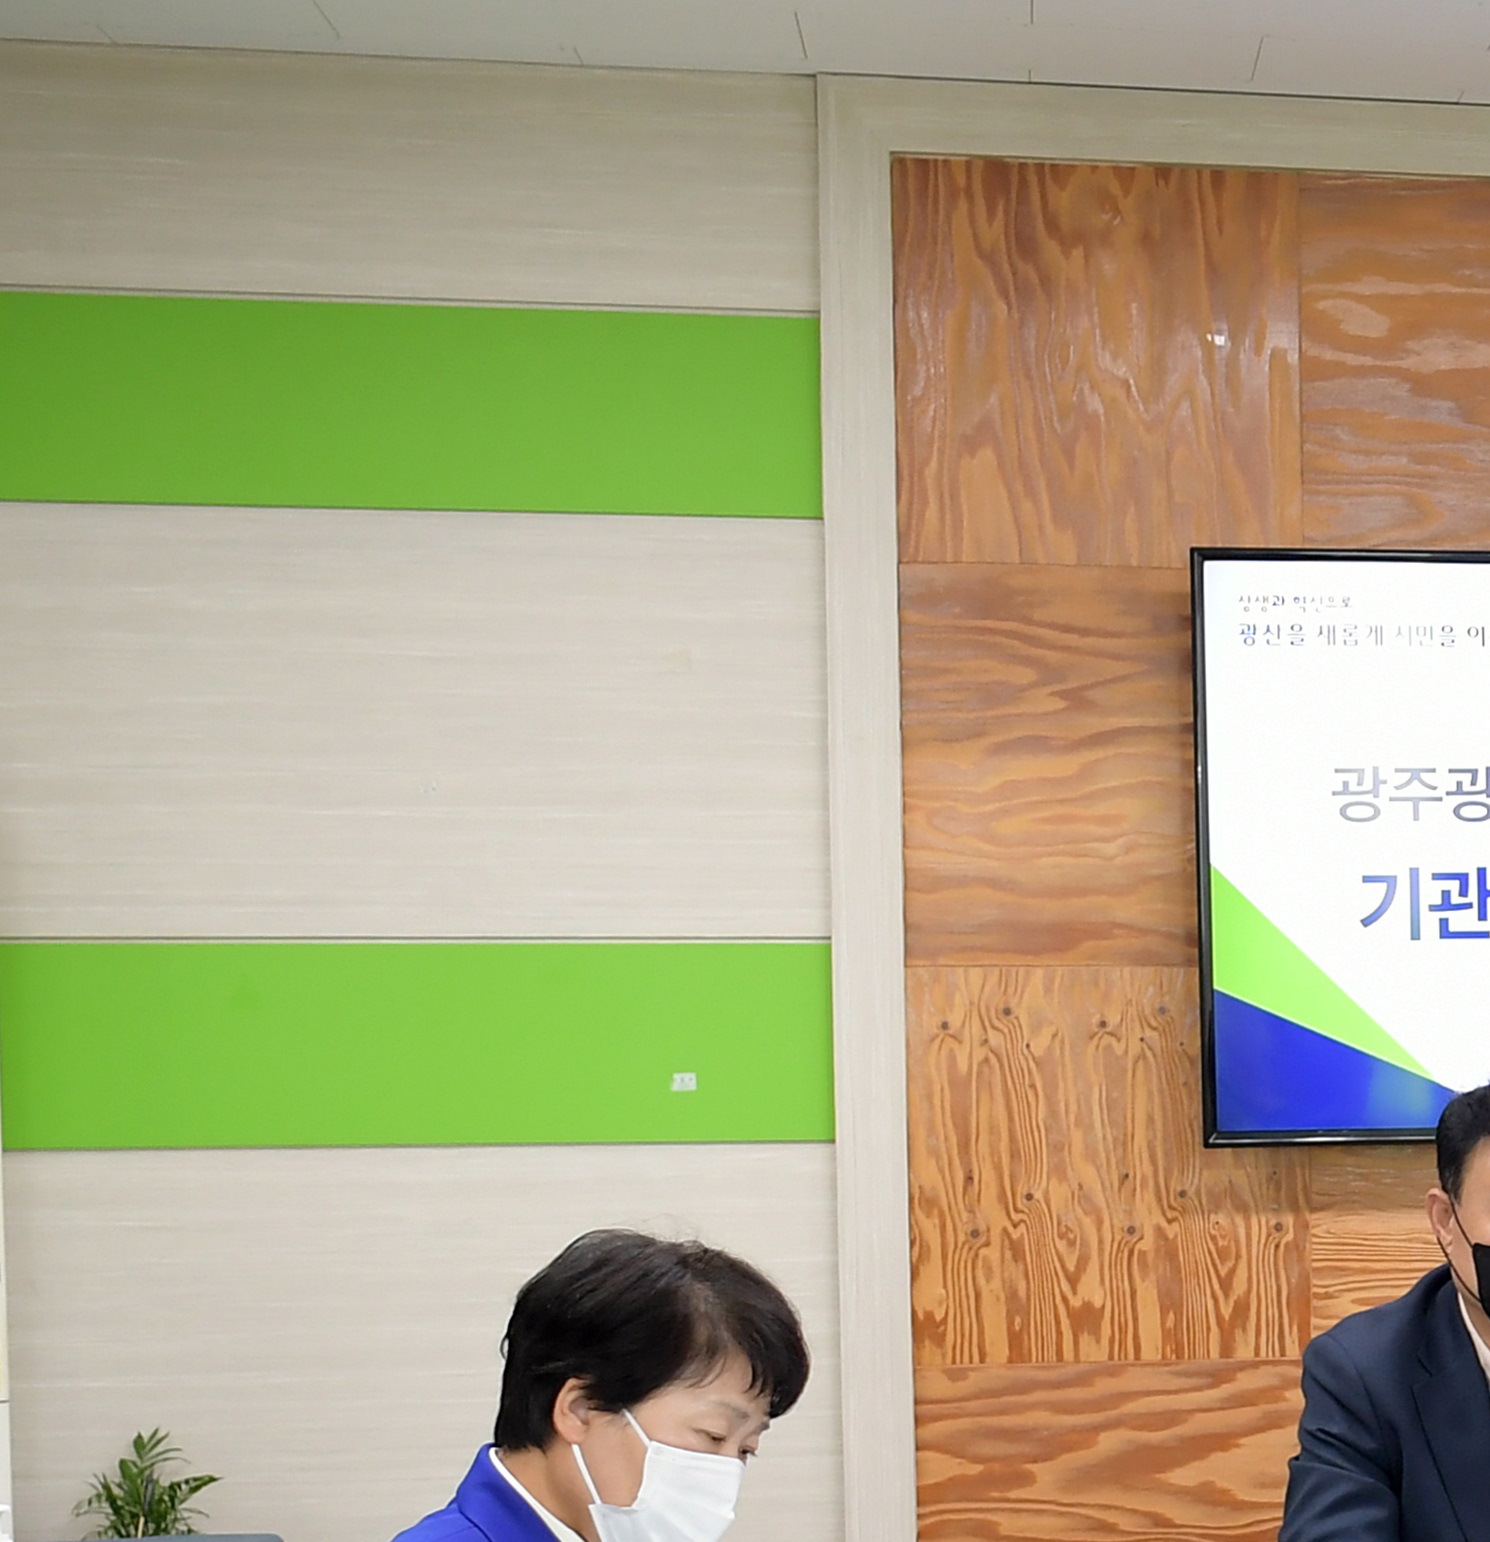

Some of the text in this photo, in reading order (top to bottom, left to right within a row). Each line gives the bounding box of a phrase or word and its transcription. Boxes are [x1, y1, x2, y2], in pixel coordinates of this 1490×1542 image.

[1238, 623, 1307, 647] 광산을
[1316, 624, 1384, 646] 새롭게
[1395, 624, 1457, 647] 시민을
